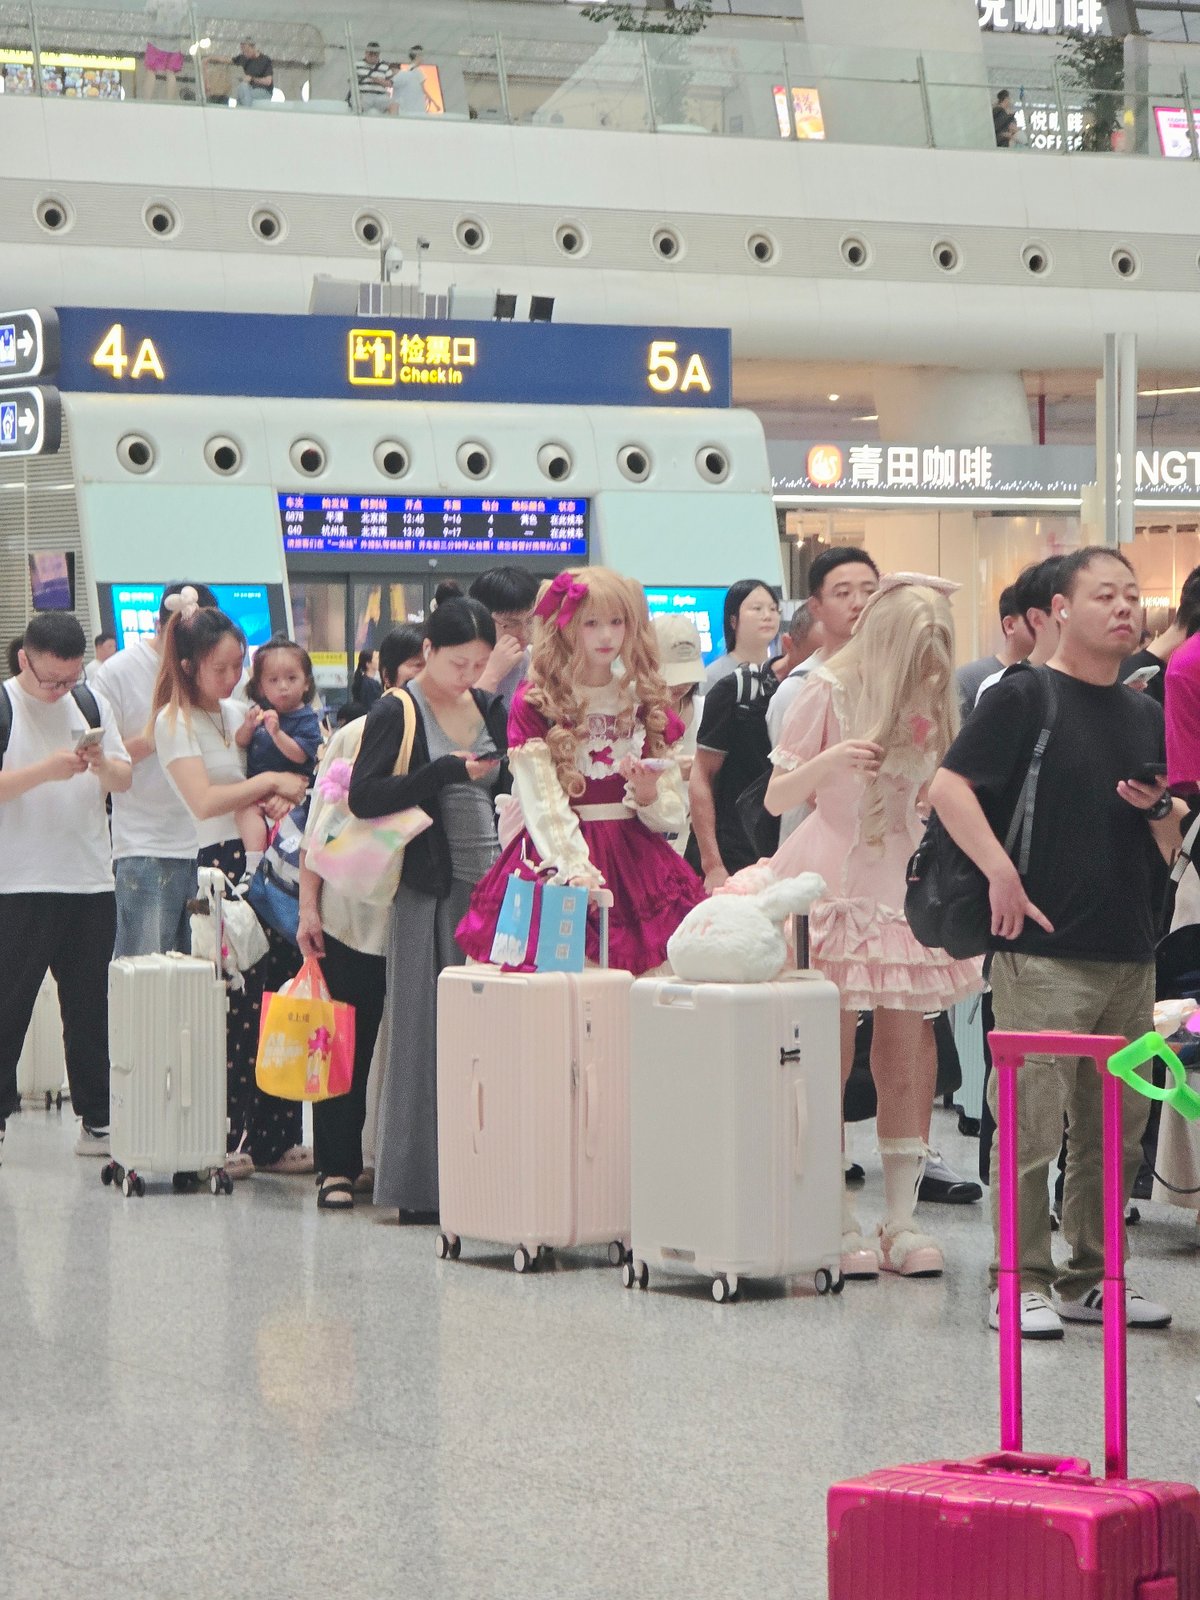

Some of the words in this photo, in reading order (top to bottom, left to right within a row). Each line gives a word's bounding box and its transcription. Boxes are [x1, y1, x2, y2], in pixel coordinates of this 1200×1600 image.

[93, 323, 165, 380] 4A
[400, 333, 476, 366] 检票口
[400, 366, 446, 384] Check
[647, 341, 712, 393] 5A
[849, 444, 992, 486] 青田咖啡
[361, 512, 388, 524] 北京南
[488, 514, 494, 525] 4
[520, 514, 538, 526] 黄色
[550, 514, 584, 526] 在此候车
[482, 500, 499, 512] 站台
[558, 500, 576, 513] 状态
[321, 524, 348, 537] 杭州东
[361, 525, 388, 538] 北京南
[550, 527, 584, 539] 在此候车
